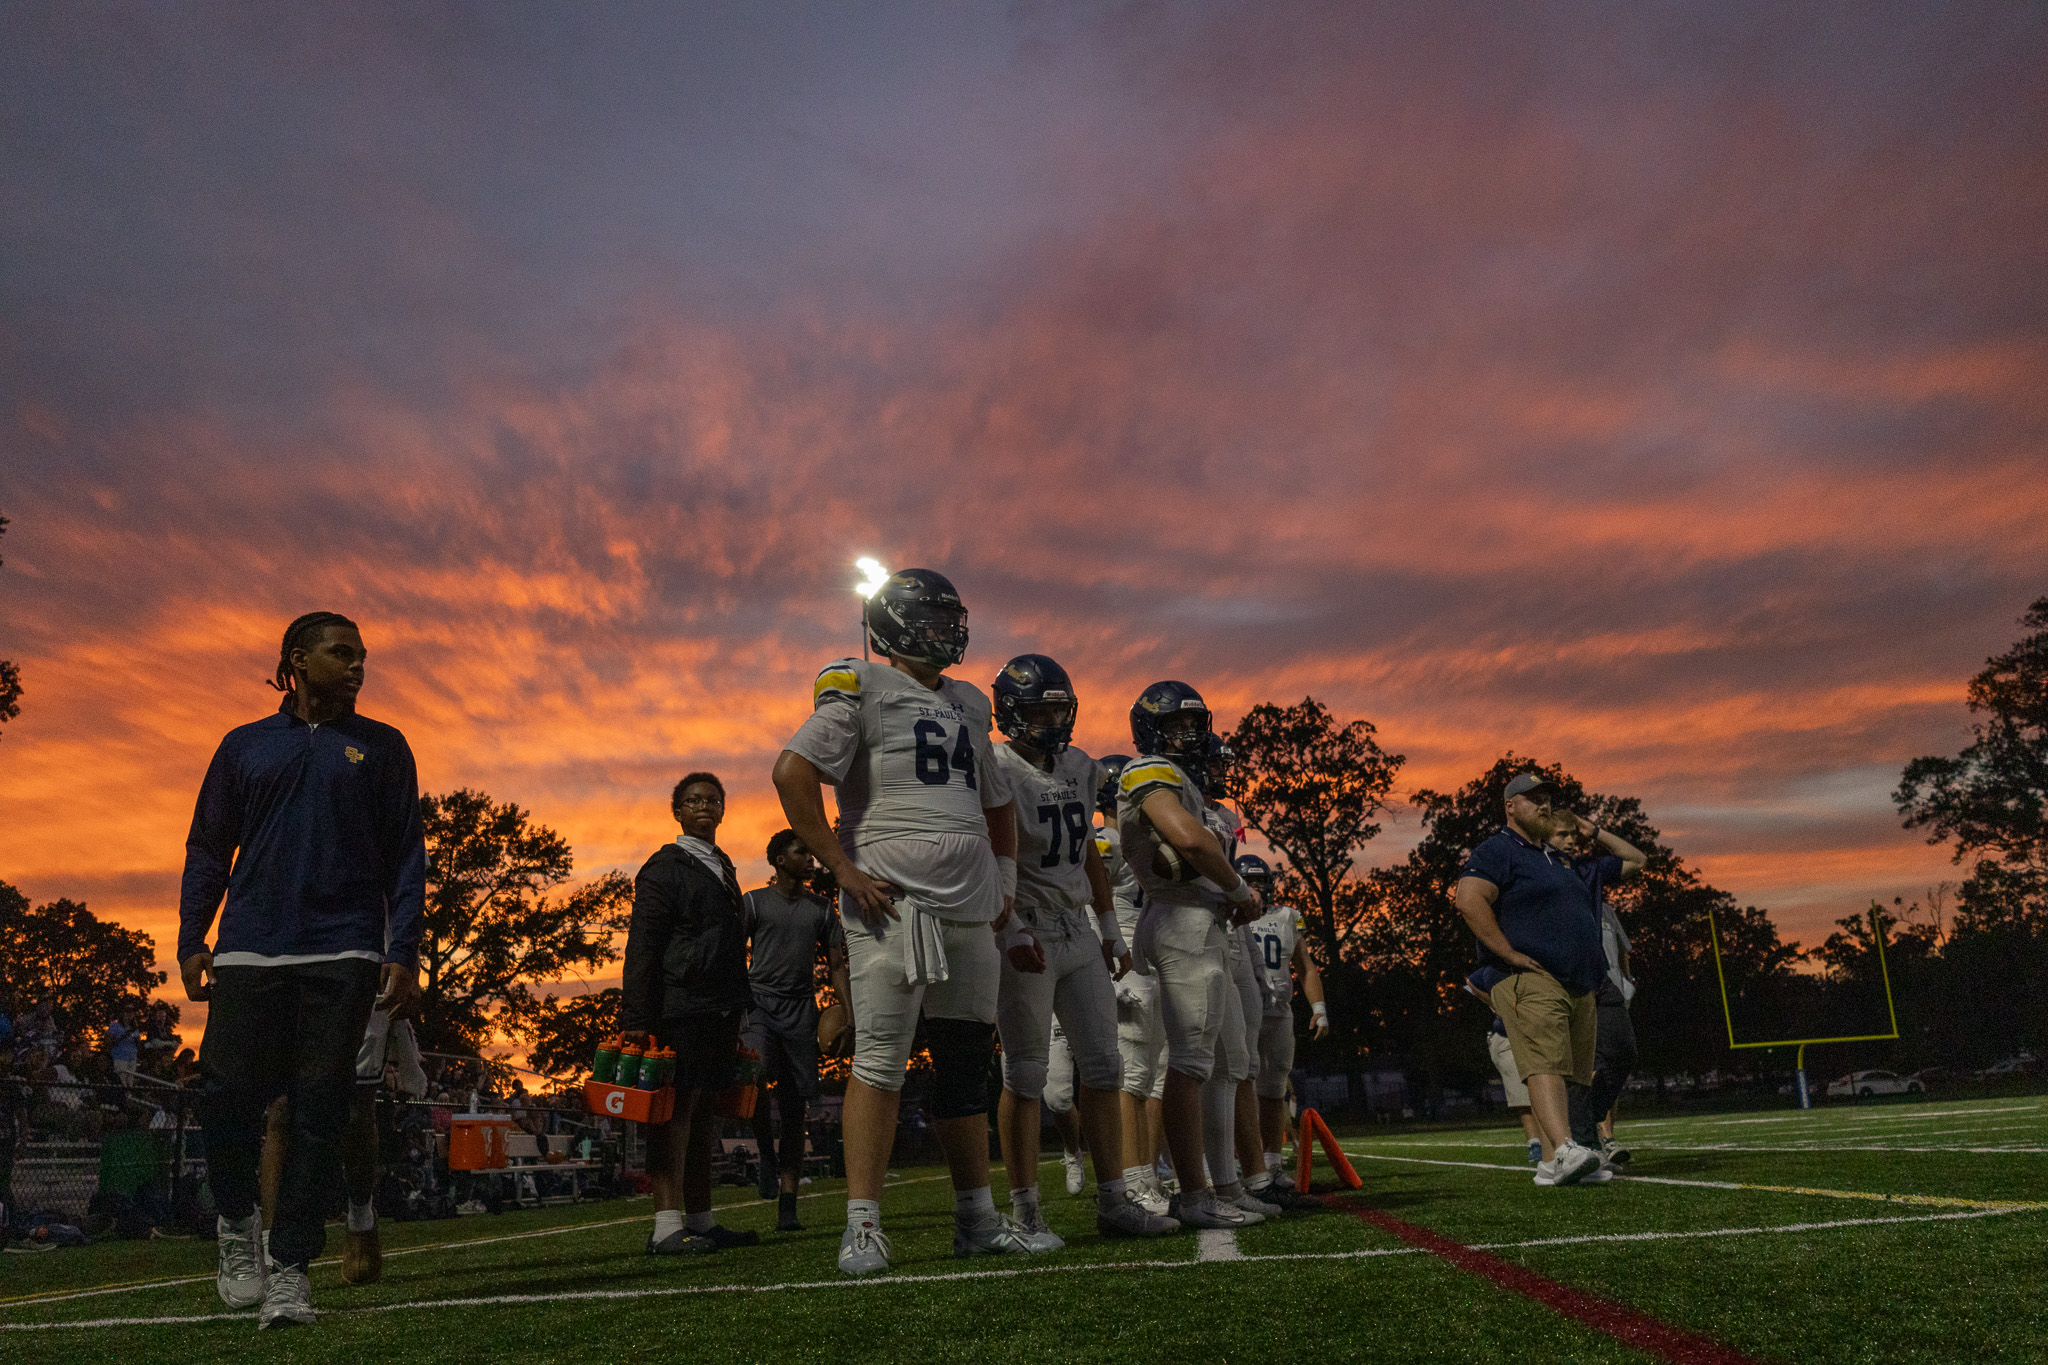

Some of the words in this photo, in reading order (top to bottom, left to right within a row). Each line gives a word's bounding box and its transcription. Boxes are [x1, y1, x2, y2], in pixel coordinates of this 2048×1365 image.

[919, 706, 931, 717] ST.
[935, 709, 962, 721] PAUL'S
[913, 719, 977, 791] 64
[1041, 793, 1051, 801] ST.
[1053, 790, 1077, 800] PAUL'S
[1037, 801, 1088, 868] 78
[1253, 933, 1282, 970] 0
[605, 1091, 625, 1114] G
